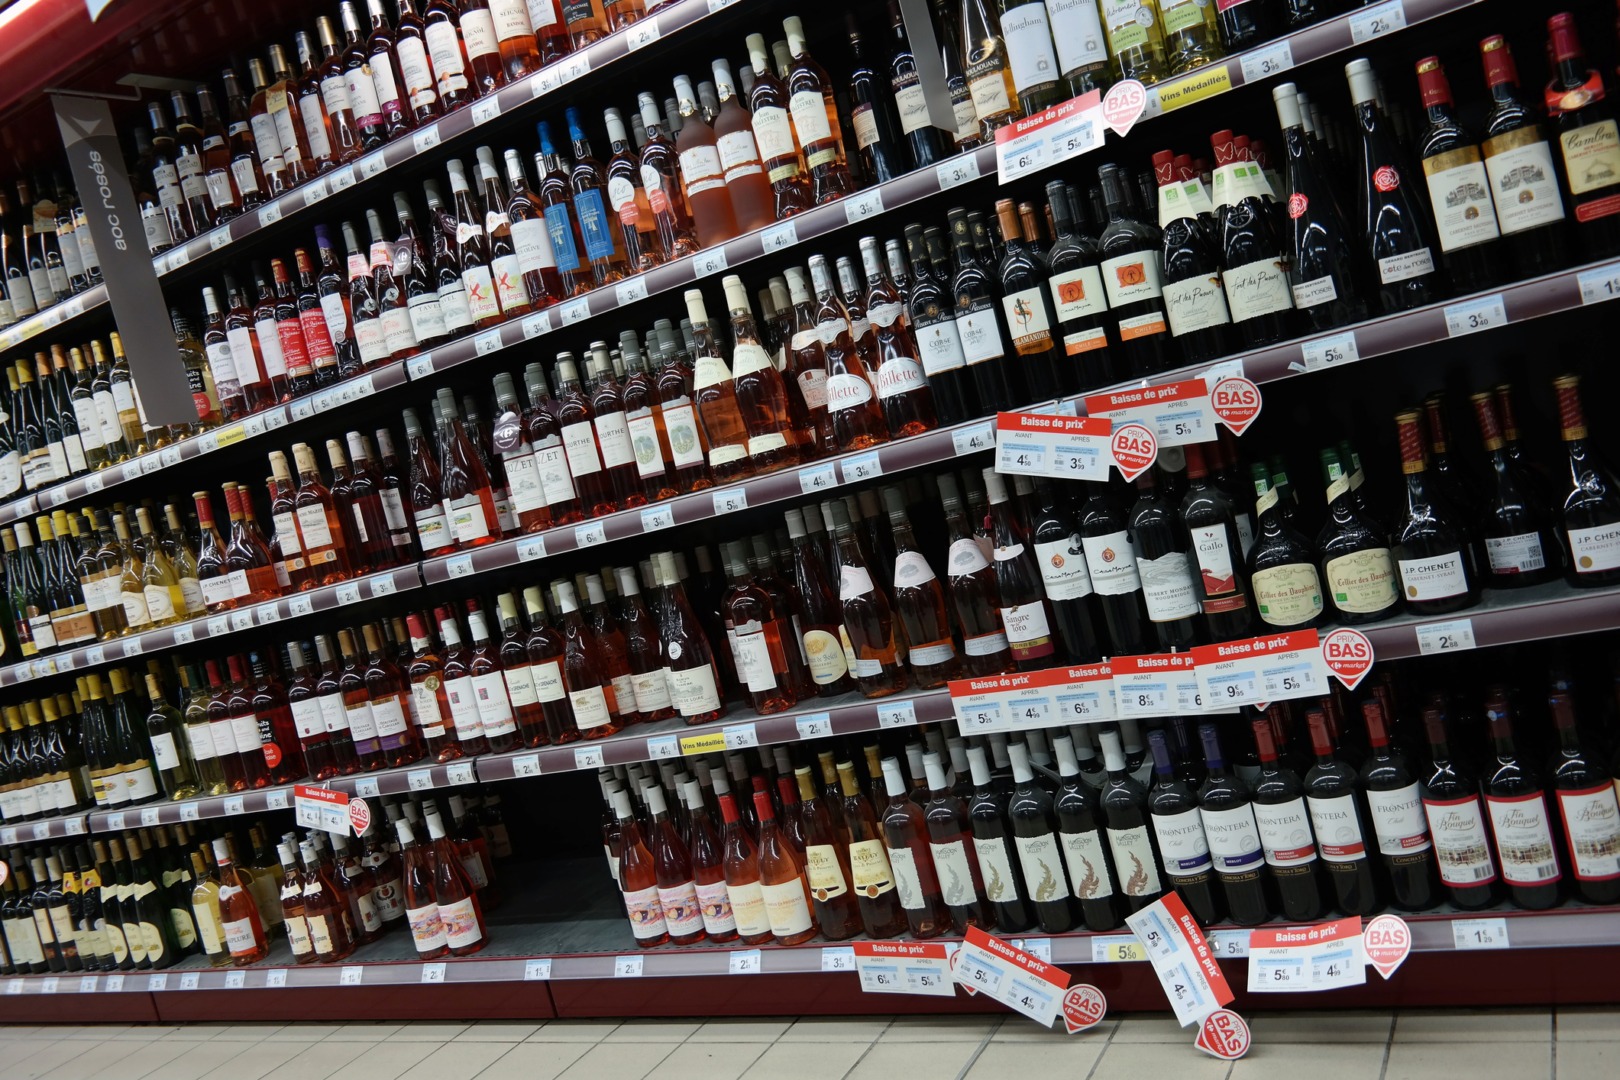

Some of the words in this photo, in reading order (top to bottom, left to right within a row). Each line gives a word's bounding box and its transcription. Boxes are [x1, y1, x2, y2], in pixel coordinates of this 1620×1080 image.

[1116, 86, 1131, 95] PRIX
[1161, 92, 1181, 102] Vins
[1183, 75, 1227, 94] Médaillés
[1108, 91, 1140, 111] BAS
[1016, 115, 1044, 133] Baisse
[1046, 110, 1056, 118] de
[1013, 136, 1030, 146] AVANT
[89, 151, 116, 209] rosés
[111, 215, 127, 250] aoc
[1111, 392, 1141, 406] Baisse
[1144, 390, 1156, 400] de
[1218, 390, 1255, 405] BAS
[1109, 410, 1127, 418] AVANT
[1021, 416, 1050, 427] Baisse
[1052, 418, 1063, 428] de
[1127, 430, 1144, 439] PRIX
[1117, 436, 1151, 454] BAS
[1200, 542, 1223, 552] Gallo
[1418, 561, 1455, 573] CHENET
[1006, 613, 1029, 626] Sangre
[1336, 635, 1355, 643] PRIX
[1218, 643, 1250, 656] Baisse
[1253, 641, 1265, 650] de
[1329, 643, 1367, 657] BAS
[1137, 657, 1168, 668] Baisse
[1171, 656, 1183, 666] de
[1215, 662, 1234, 670] AVANT
[1069, 666, 1097, 678] Baisse
[1100, 666, 1111, 675] de
[970, 679, 998, 690] Baisse
[1000, 678, 1010, 687] de
[696, 739, 724, 748] Médaillés
[1378, 800, 1420, 812] FRONTER
[352, 806, 367, 819] BAS
[1206, 821, 1249, 832] FRONTERA
[1166, 917, 1181, 934] AVANT
[1378, 921, 1395, 930] PRIX
[1180, 914, 1202, 945] Baisse
[1197, 945, 1207, 957] de
[1276, 931, 1306, 942] Baisse
[1308, 930, 1318, 940] de
[1369, 930, 1405, 945] BAS
[872, 944, 896, 954] Baisse
[899, 945, 908, 954] de
[988, 938, 1014, 959] Baisse
[1016, 952, 1026, 963] de
[979, 950, 996, 961] AVANT
[1081, 989, 1097, 1000] PRIX
[1069, 992, 1100, 1014] BAS
[1216, 1016, 1241, 1052] BAS
[1233, 1020, 1246, 1039] PRIX
